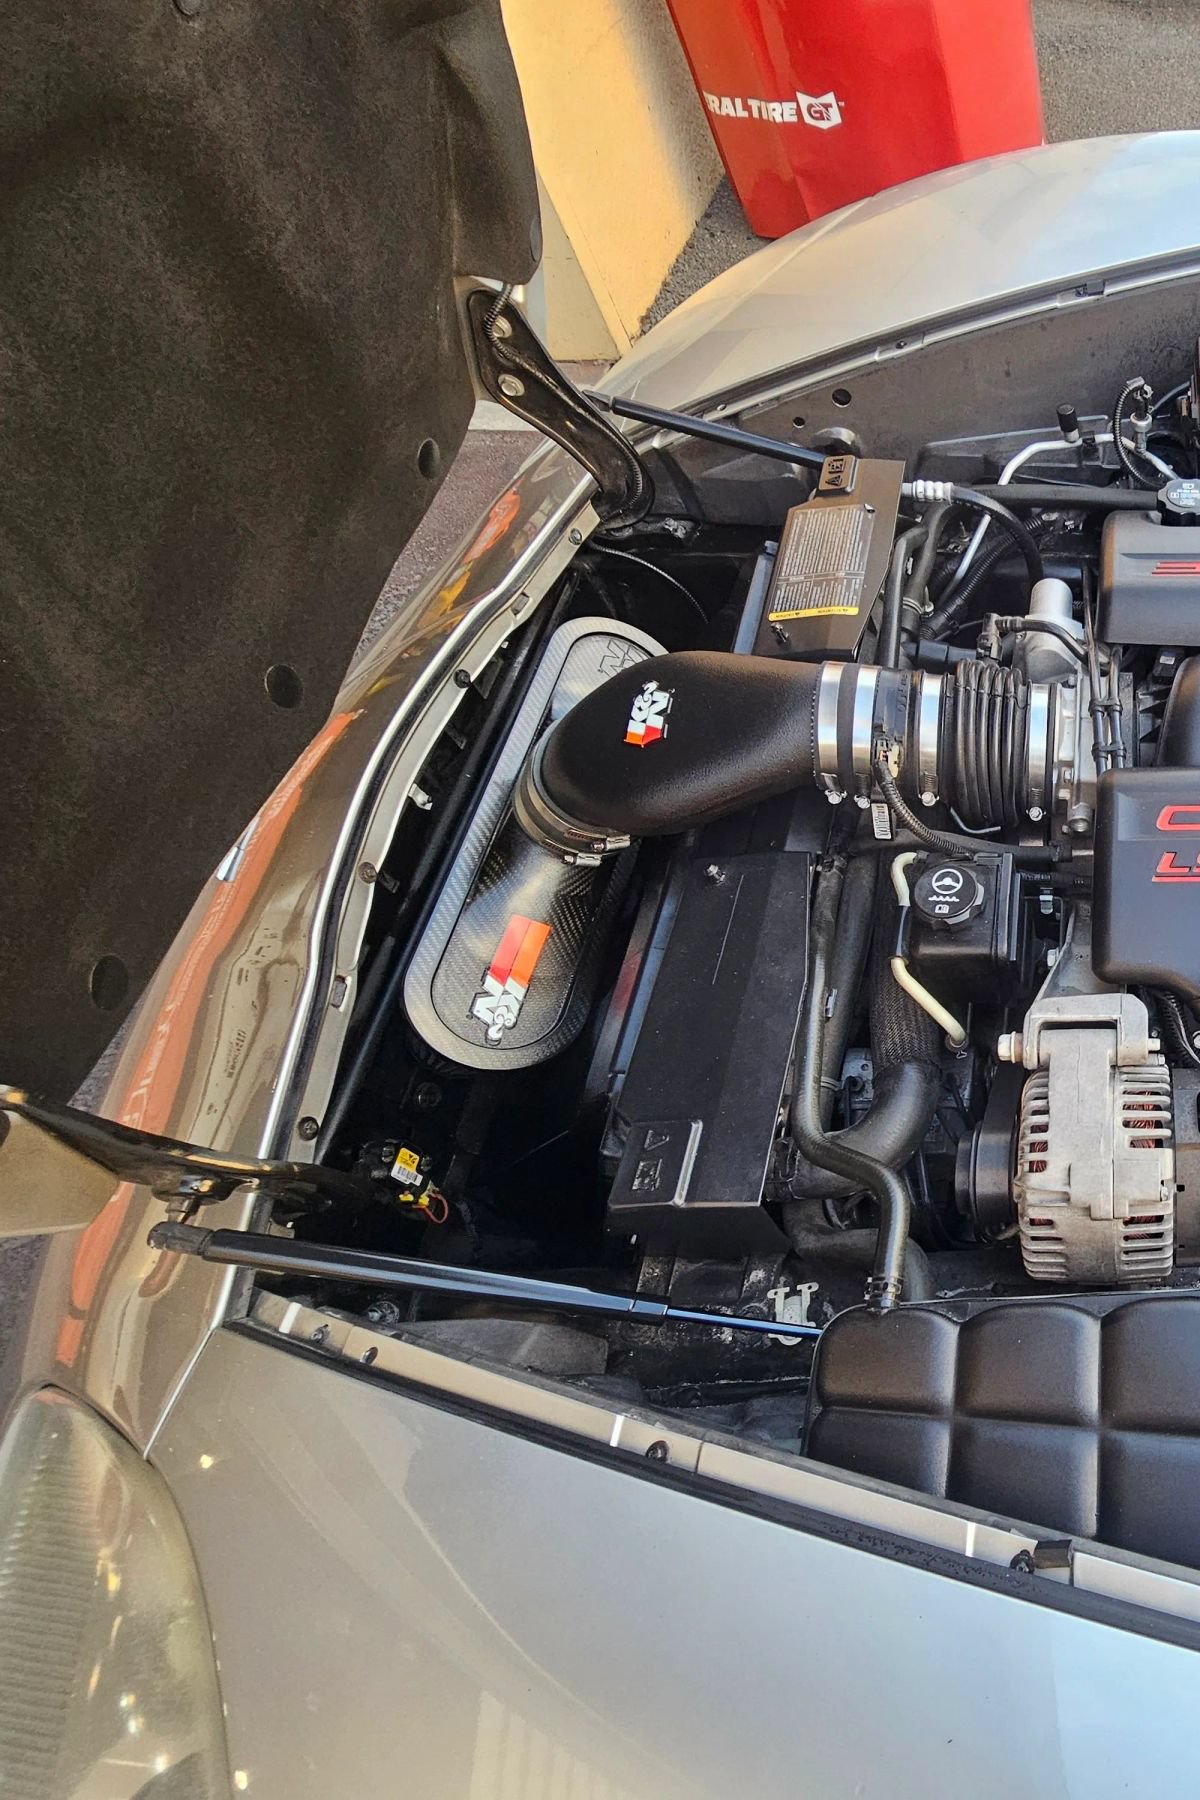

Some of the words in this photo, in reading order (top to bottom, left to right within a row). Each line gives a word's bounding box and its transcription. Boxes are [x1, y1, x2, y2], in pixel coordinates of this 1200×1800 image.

[748, 99, 798, 123] TIRE
[627, 681, 671, 742] K&N
[469, 973, 529, 1043] K&N
